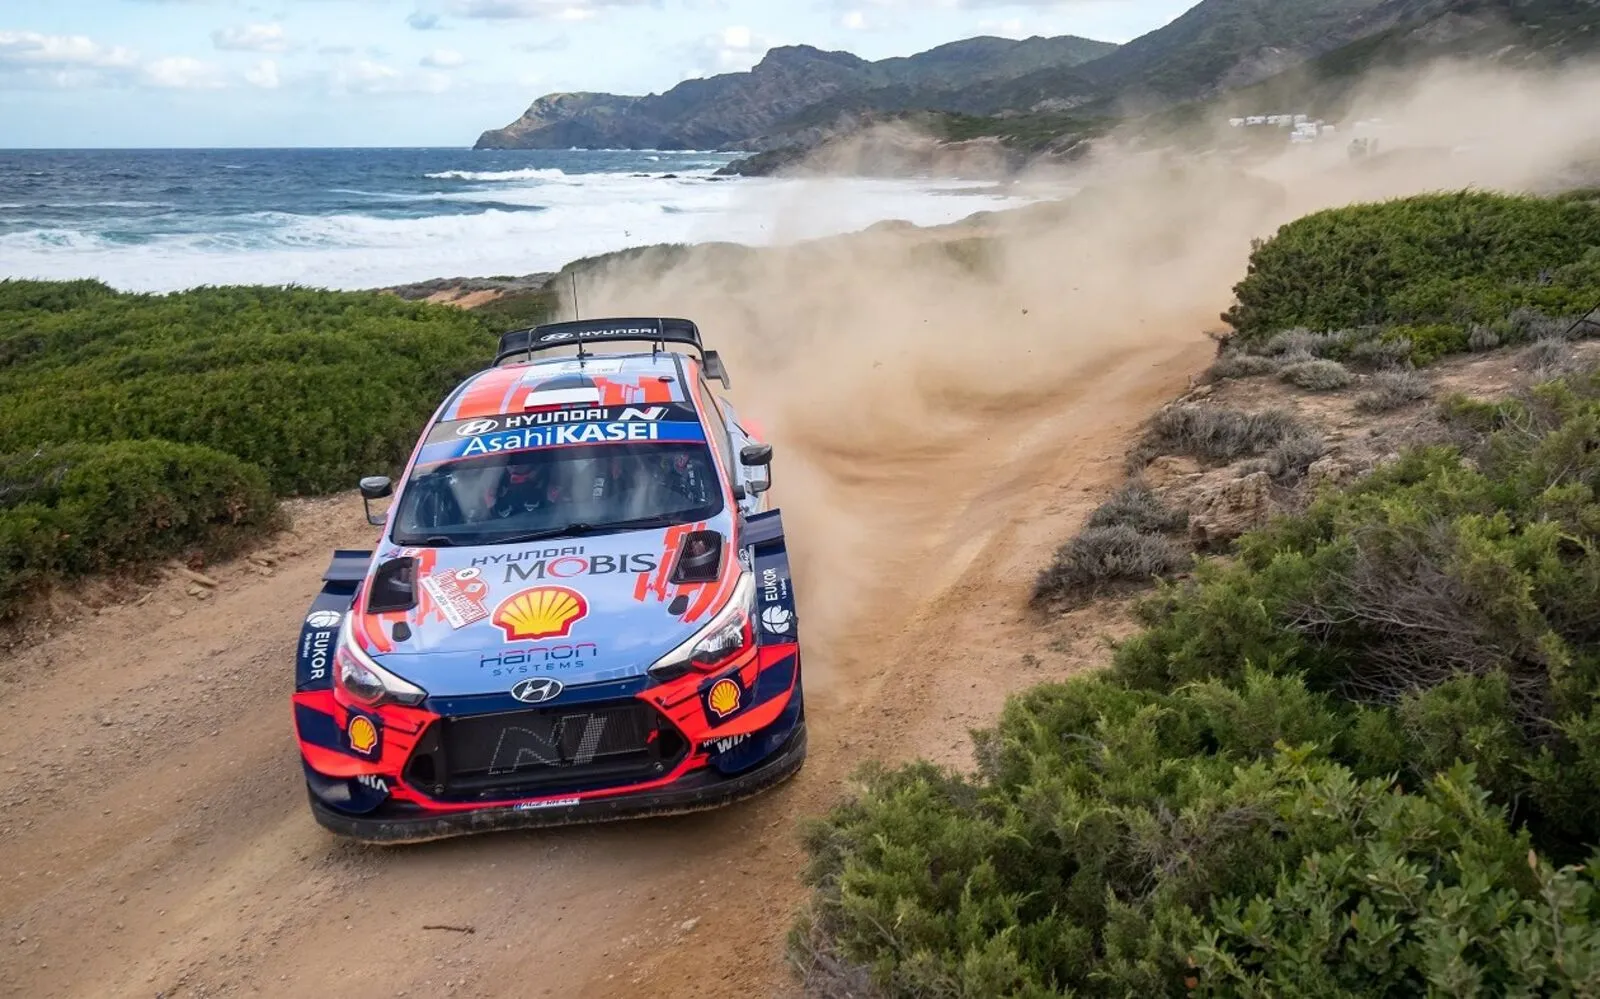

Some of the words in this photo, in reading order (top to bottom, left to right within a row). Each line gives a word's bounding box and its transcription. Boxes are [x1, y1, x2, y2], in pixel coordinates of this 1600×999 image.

[579, 328, 657, 338] HYUNDAI
[505, 408, 608, 428] HYUNDAI
[471, 546, 585, 567] HYUNDAI
[504, 553, 657, 583] MOBIS
[763, 567, 778, 602] EUKOR
[311, 631, 331, 681] EUKOR
[493, 659, 585, 677] SYSTEMS
